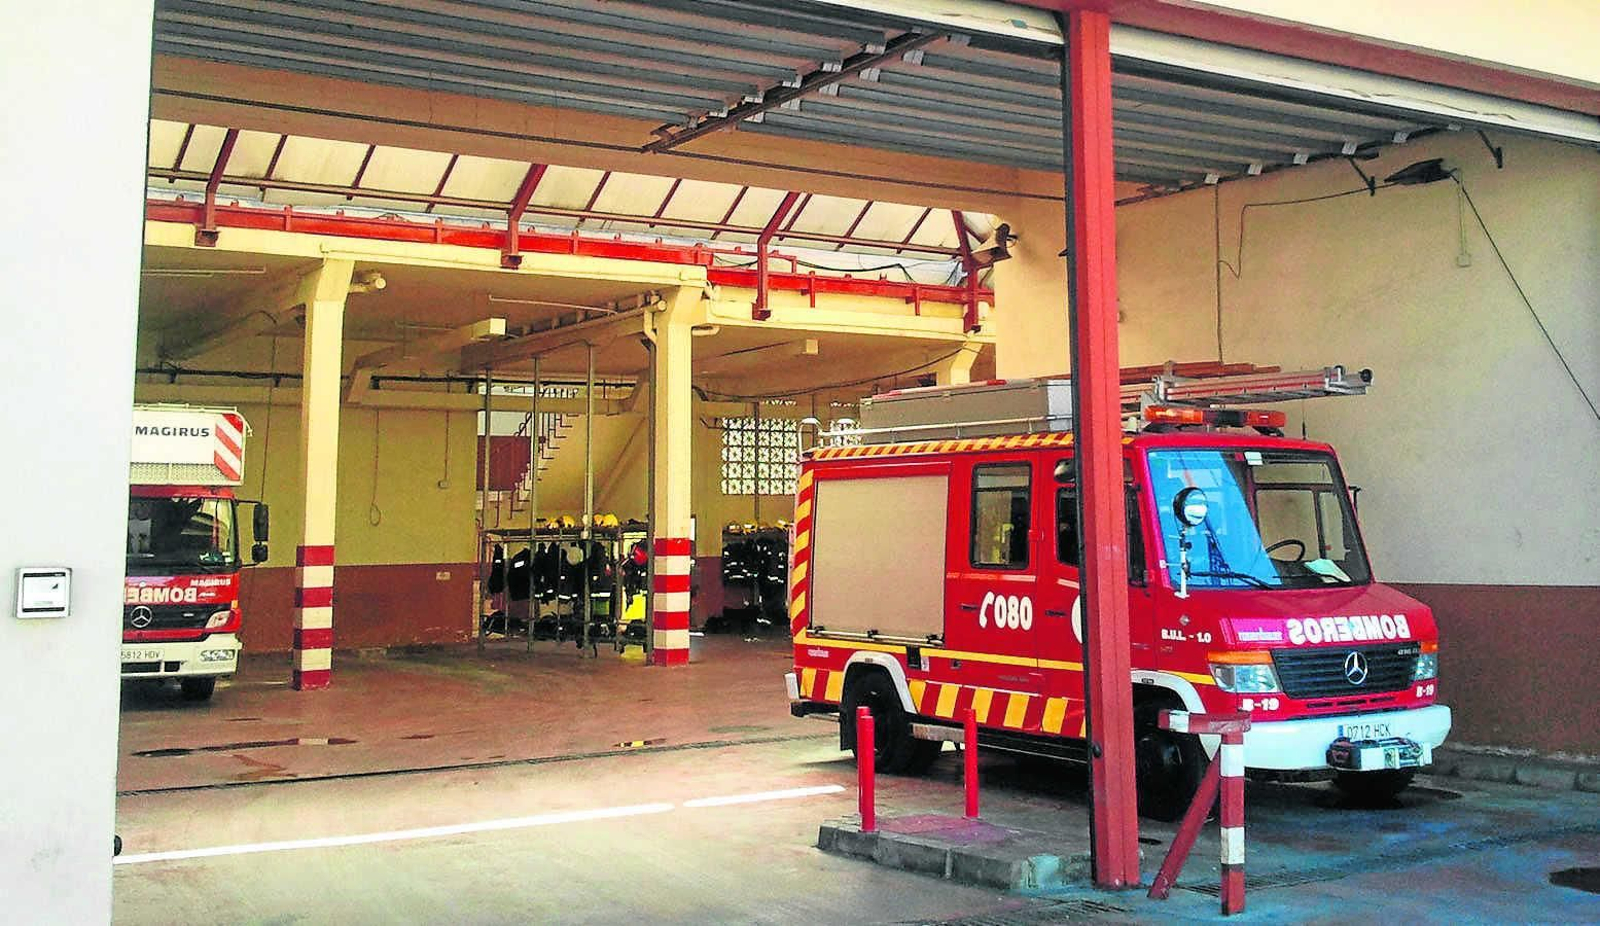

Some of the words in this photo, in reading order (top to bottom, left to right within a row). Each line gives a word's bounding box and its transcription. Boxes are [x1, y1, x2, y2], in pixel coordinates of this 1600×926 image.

[135, 426, 210, 437] MAGIRUS
[994, 594, 1033, 631] 080
[1416, 684, 1435, 699] B-19
[1243, 697, 1280, 712] B-19
[1346, 725, 1371, 740] 0712
[1374, 723, 1392, 738] HCK
